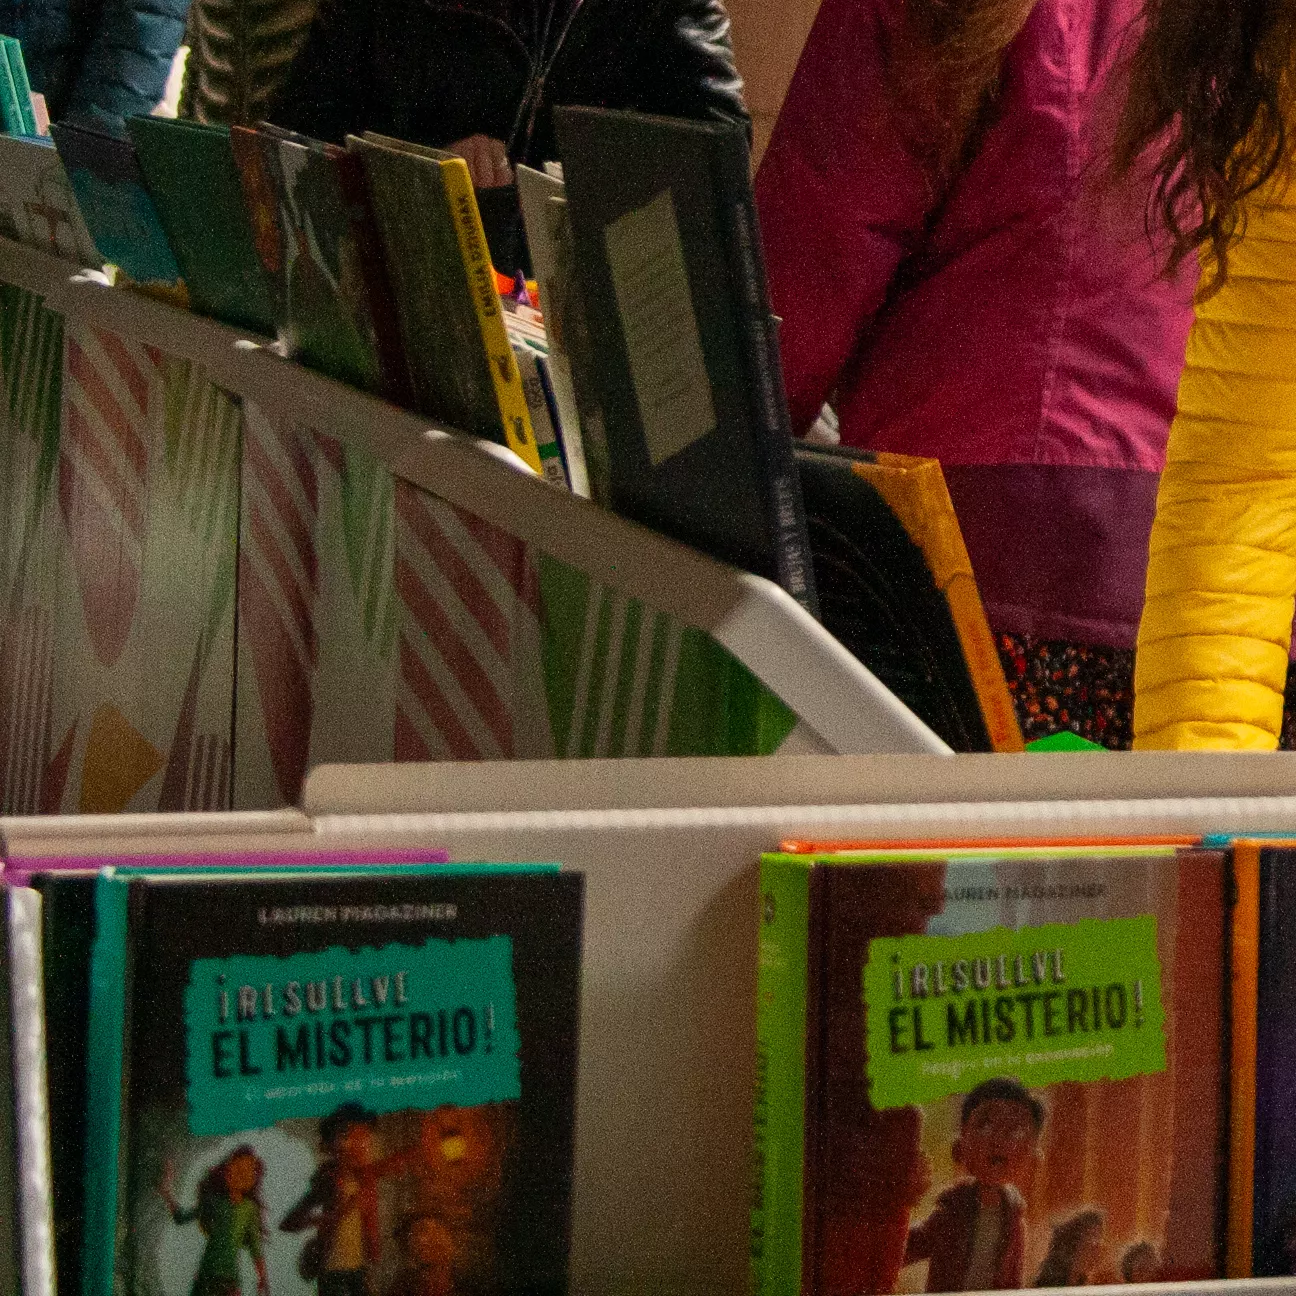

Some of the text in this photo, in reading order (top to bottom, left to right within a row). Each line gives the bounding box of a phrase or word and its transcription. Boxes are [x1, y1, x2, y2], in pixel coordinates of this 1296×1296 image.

[257, 906, 337, 925] LAUREN
[217, 970, 408, 1025] ¡RESUELVE
[889, 948, 1067, 1002] ¡RESUELVE
[211, 1002, 495, 1078] EL MISTERIO!
[888, 979, 1145, 1055] EL MISTERIO!
